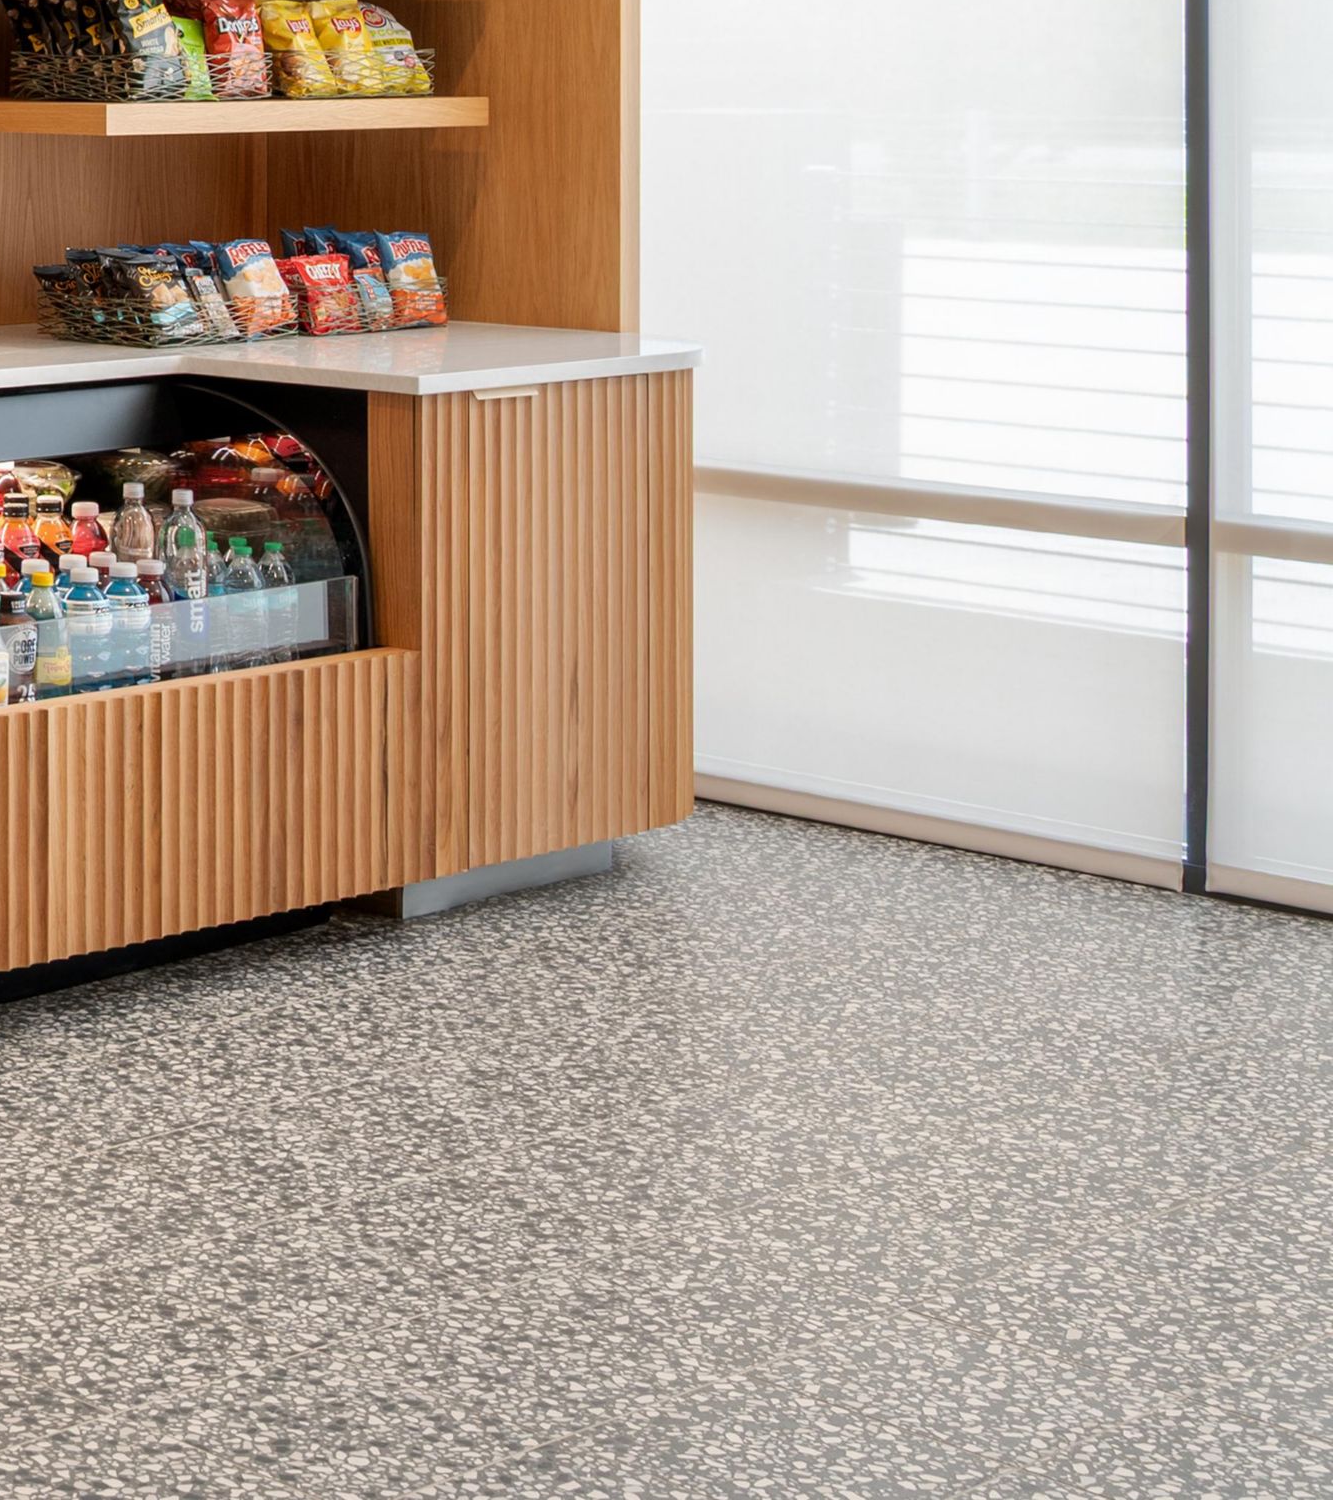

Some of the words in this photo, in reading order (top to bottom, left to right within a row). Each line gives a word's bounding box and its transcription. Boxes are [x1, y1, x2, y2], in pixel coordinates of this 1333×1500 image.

[218, 17, 259, 33] Doritos
[186, 568, 205, 633] smart
[13, 637, 37, 654] CORE
[150, 623, 162, 682] vitamin
[161, 622, 172, 662] water
[13, 653, 35, 666] POWER
